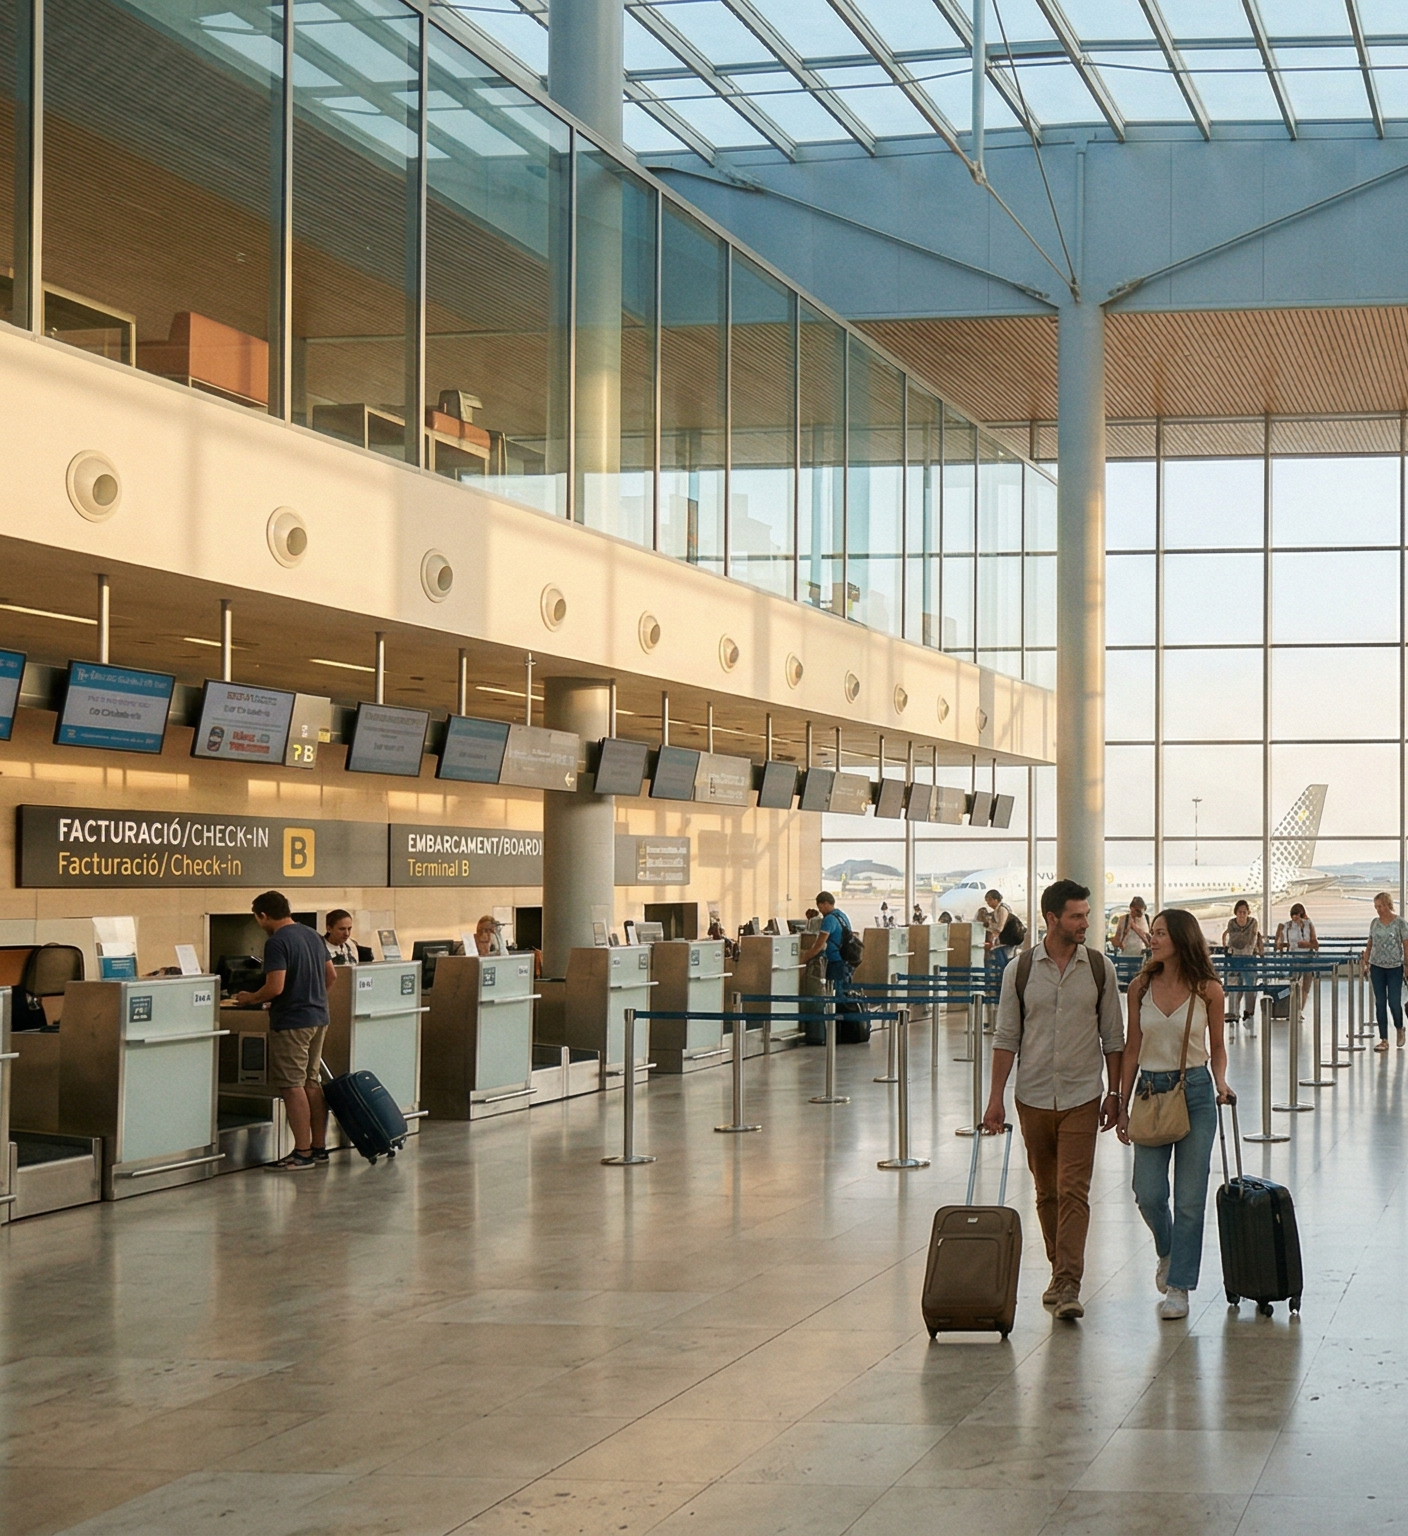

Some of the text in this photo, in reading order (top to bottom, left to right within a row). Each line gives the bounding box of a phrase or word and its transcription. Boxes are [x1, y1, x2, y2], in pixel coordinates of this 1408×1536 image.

[59, 818, 269, 848] FACTURACIÓ/CHECK-IN
[290, 836, 308, 870] B
[408, 859, 470, 877] Terminal B
